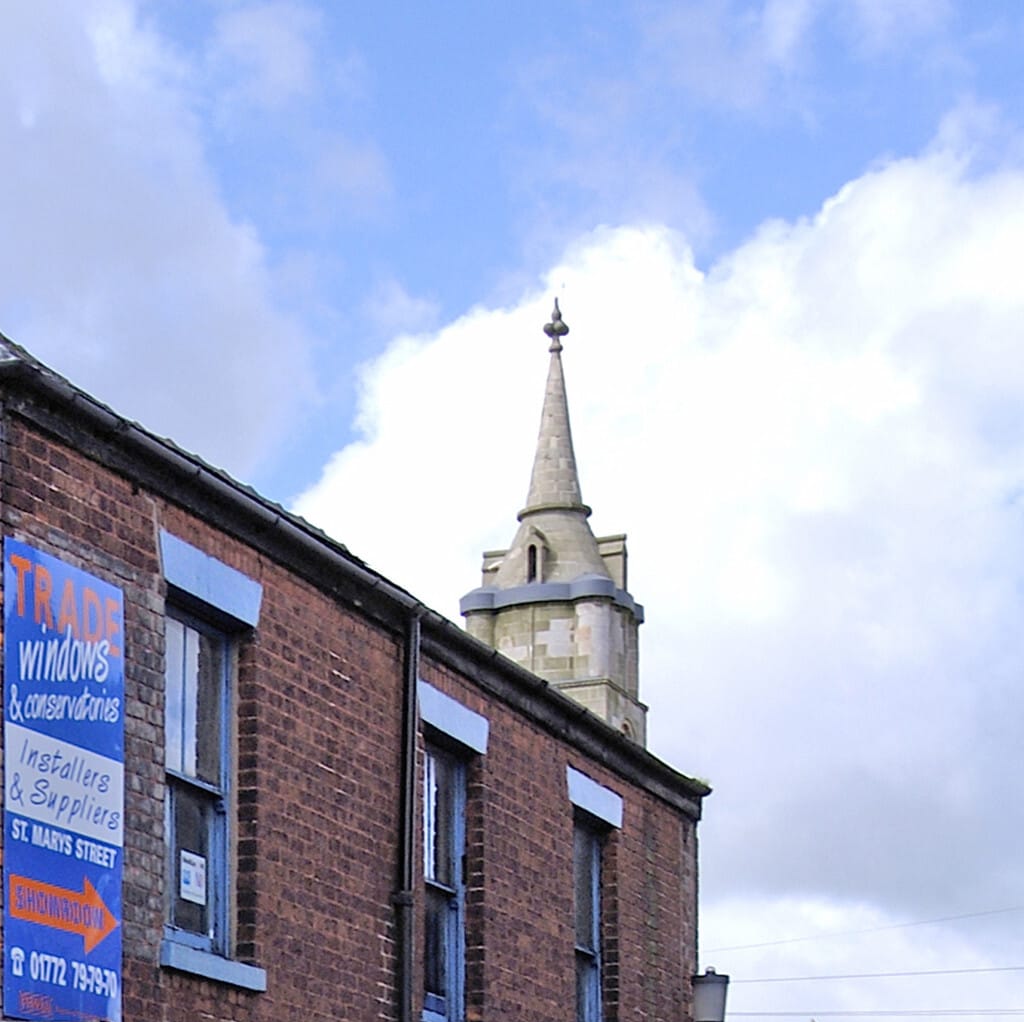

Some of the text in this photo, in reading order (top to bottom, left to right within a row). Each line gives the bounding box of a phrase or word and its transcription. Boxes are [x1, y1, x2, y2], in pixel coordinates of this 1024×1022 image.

[10, 553, 121, 657] TRADE
[19, 622, 111, 683] windows
[8, 684, 120, 723] & conservatories
[20, 739, 111, 794] Installers
[9, 772, 120, 830] & Suppliers
[11, 818, 118, 869] ST. MARYS STREET
[15, 885, 104, 930] SHOWROOM
[30, 950, 67, 987] 01772
